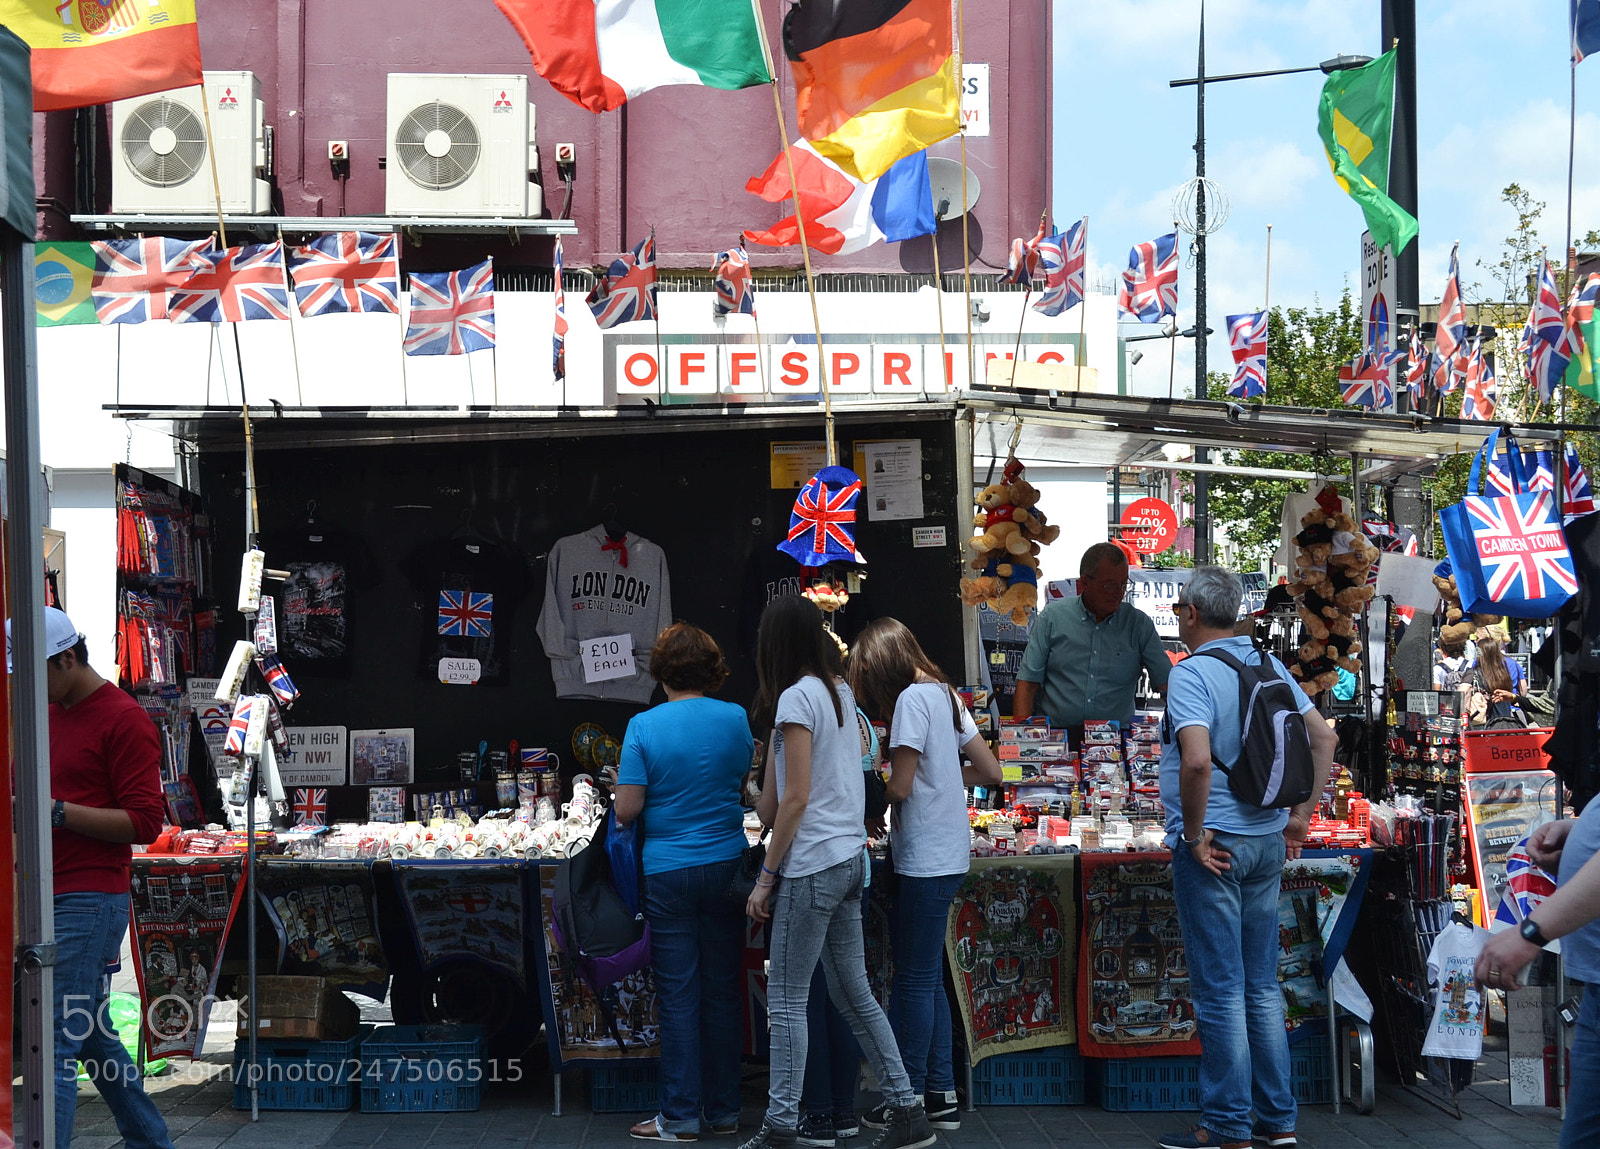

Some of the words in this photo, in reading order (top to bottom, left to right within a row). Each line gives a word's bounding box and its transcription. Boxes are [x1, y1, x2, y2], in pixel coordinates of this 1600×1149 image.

[623, 351, 1066, 387] OFFSPRI
[1140, 507, 1150, 516] UP
[1150, 508, 1160, 516] TO
[1130, 516, 1167, 537] 70%
[1136, 537, 1159, 550] OFF
[1481, 537, 1529, 555] CAMDEN
[1528, 532, 1562, 550] TOWN
[591, 641, 619, 658] £10
[447, 661, 476, 671] SALE
[594, 658, 627, 673] EACH
[449, 672, 470, 681] £2.99
[310, 732, 339, 746] HIGH
[305, 751, 332, 764] NW1
[288, 775, 298, 783] OF
[300, 774, 331, 783] CAMDEN
[1494, 789, 1518, 797] BAR
[1484, 826, 1517, 839] AFTER
[1121, 873, 1169, 883] LONDON
[1492, 873, 1501, 886] 2
